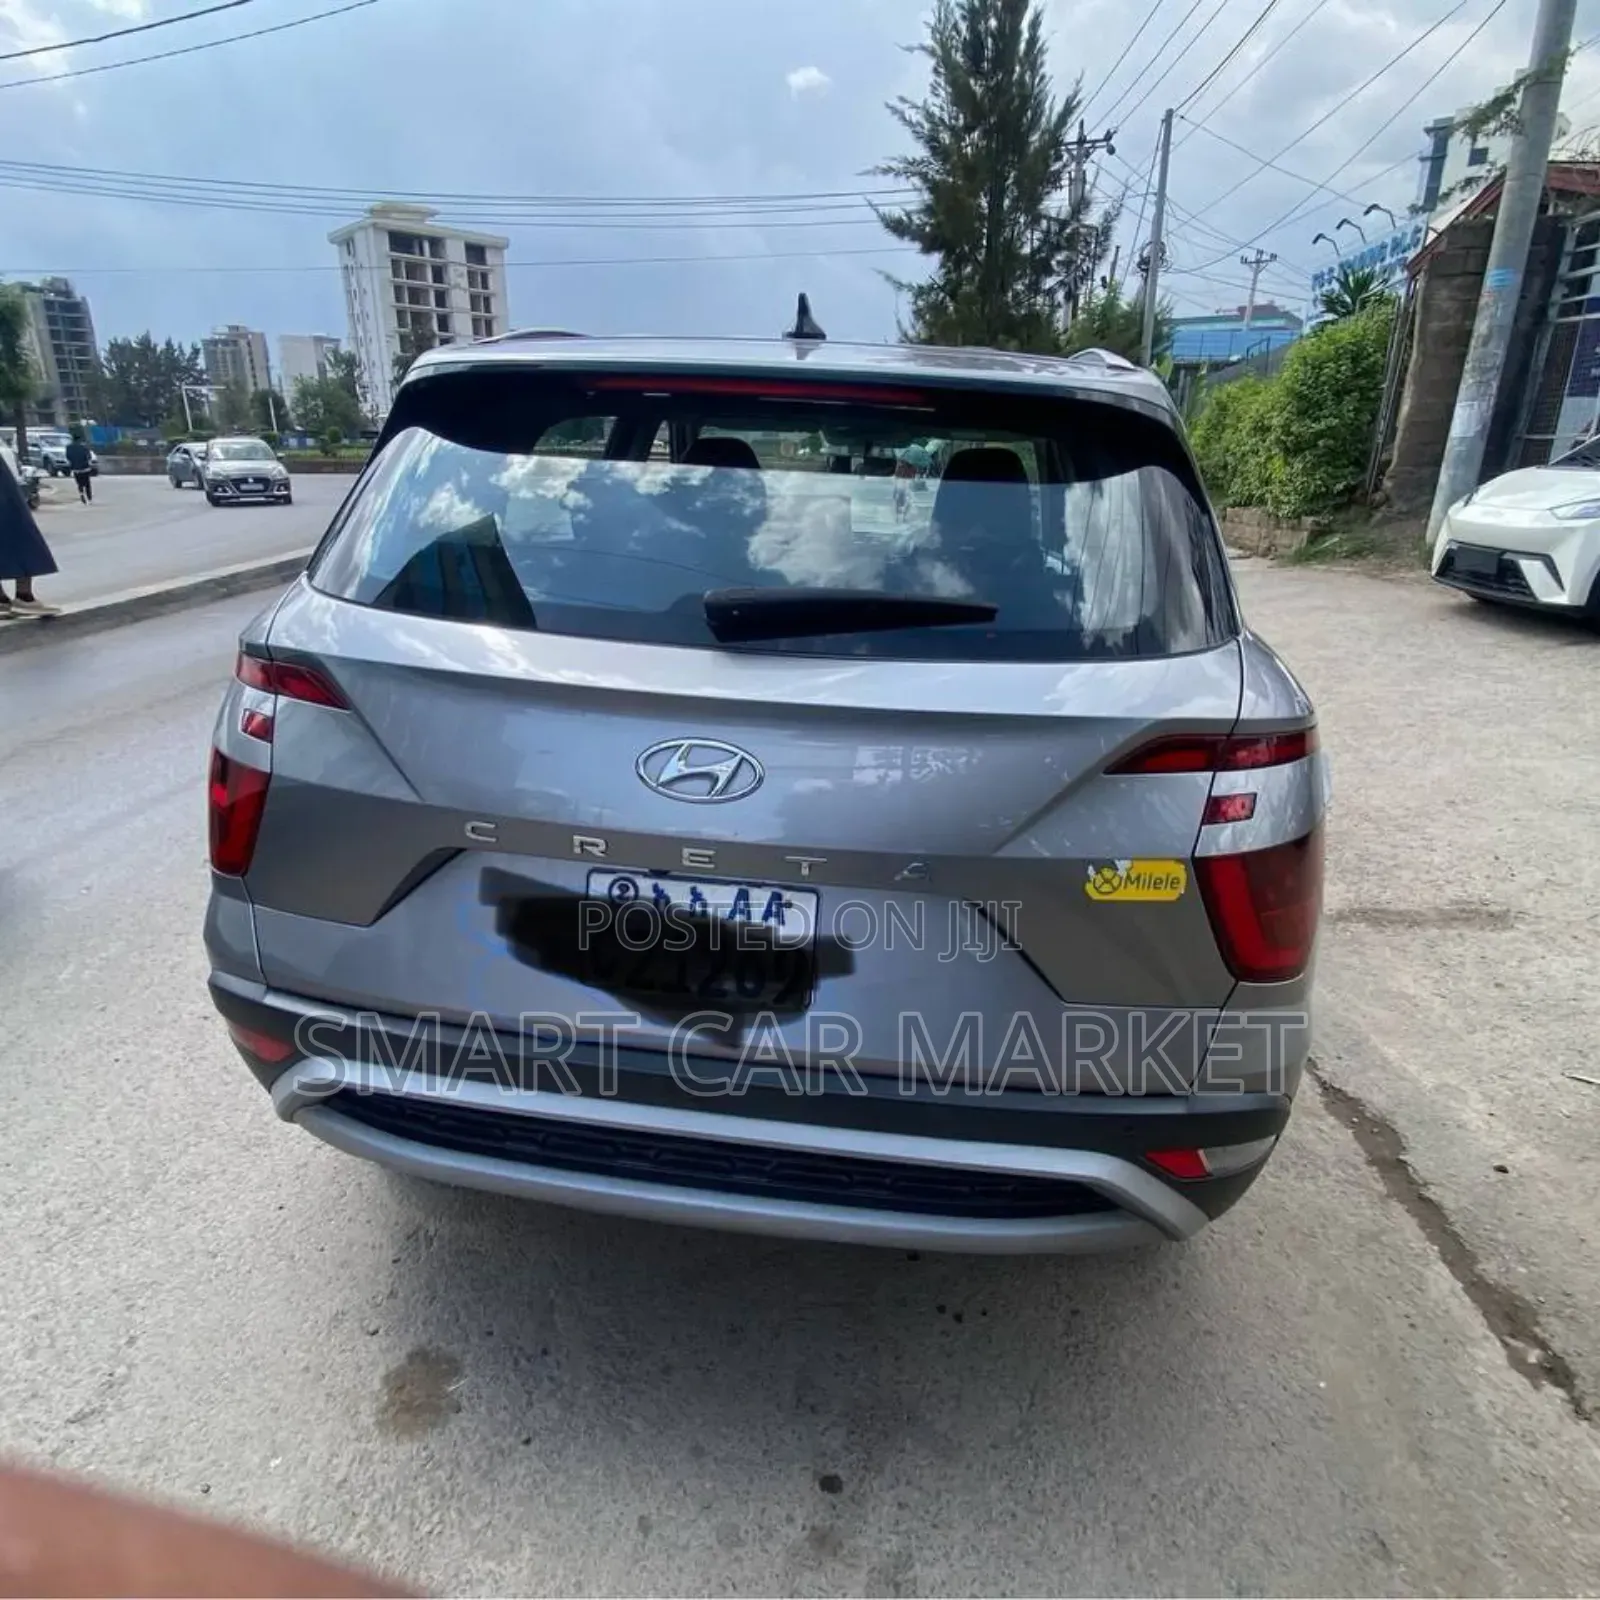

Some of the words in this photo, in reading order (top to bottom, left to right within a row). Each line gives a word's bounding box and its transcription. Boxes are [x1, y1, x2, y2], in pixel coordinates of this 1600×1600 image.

[464, 820, 931, 883] CRETA
[1122, 872, 1181, 891] Milele
[726, 887, 787, 927] AA
